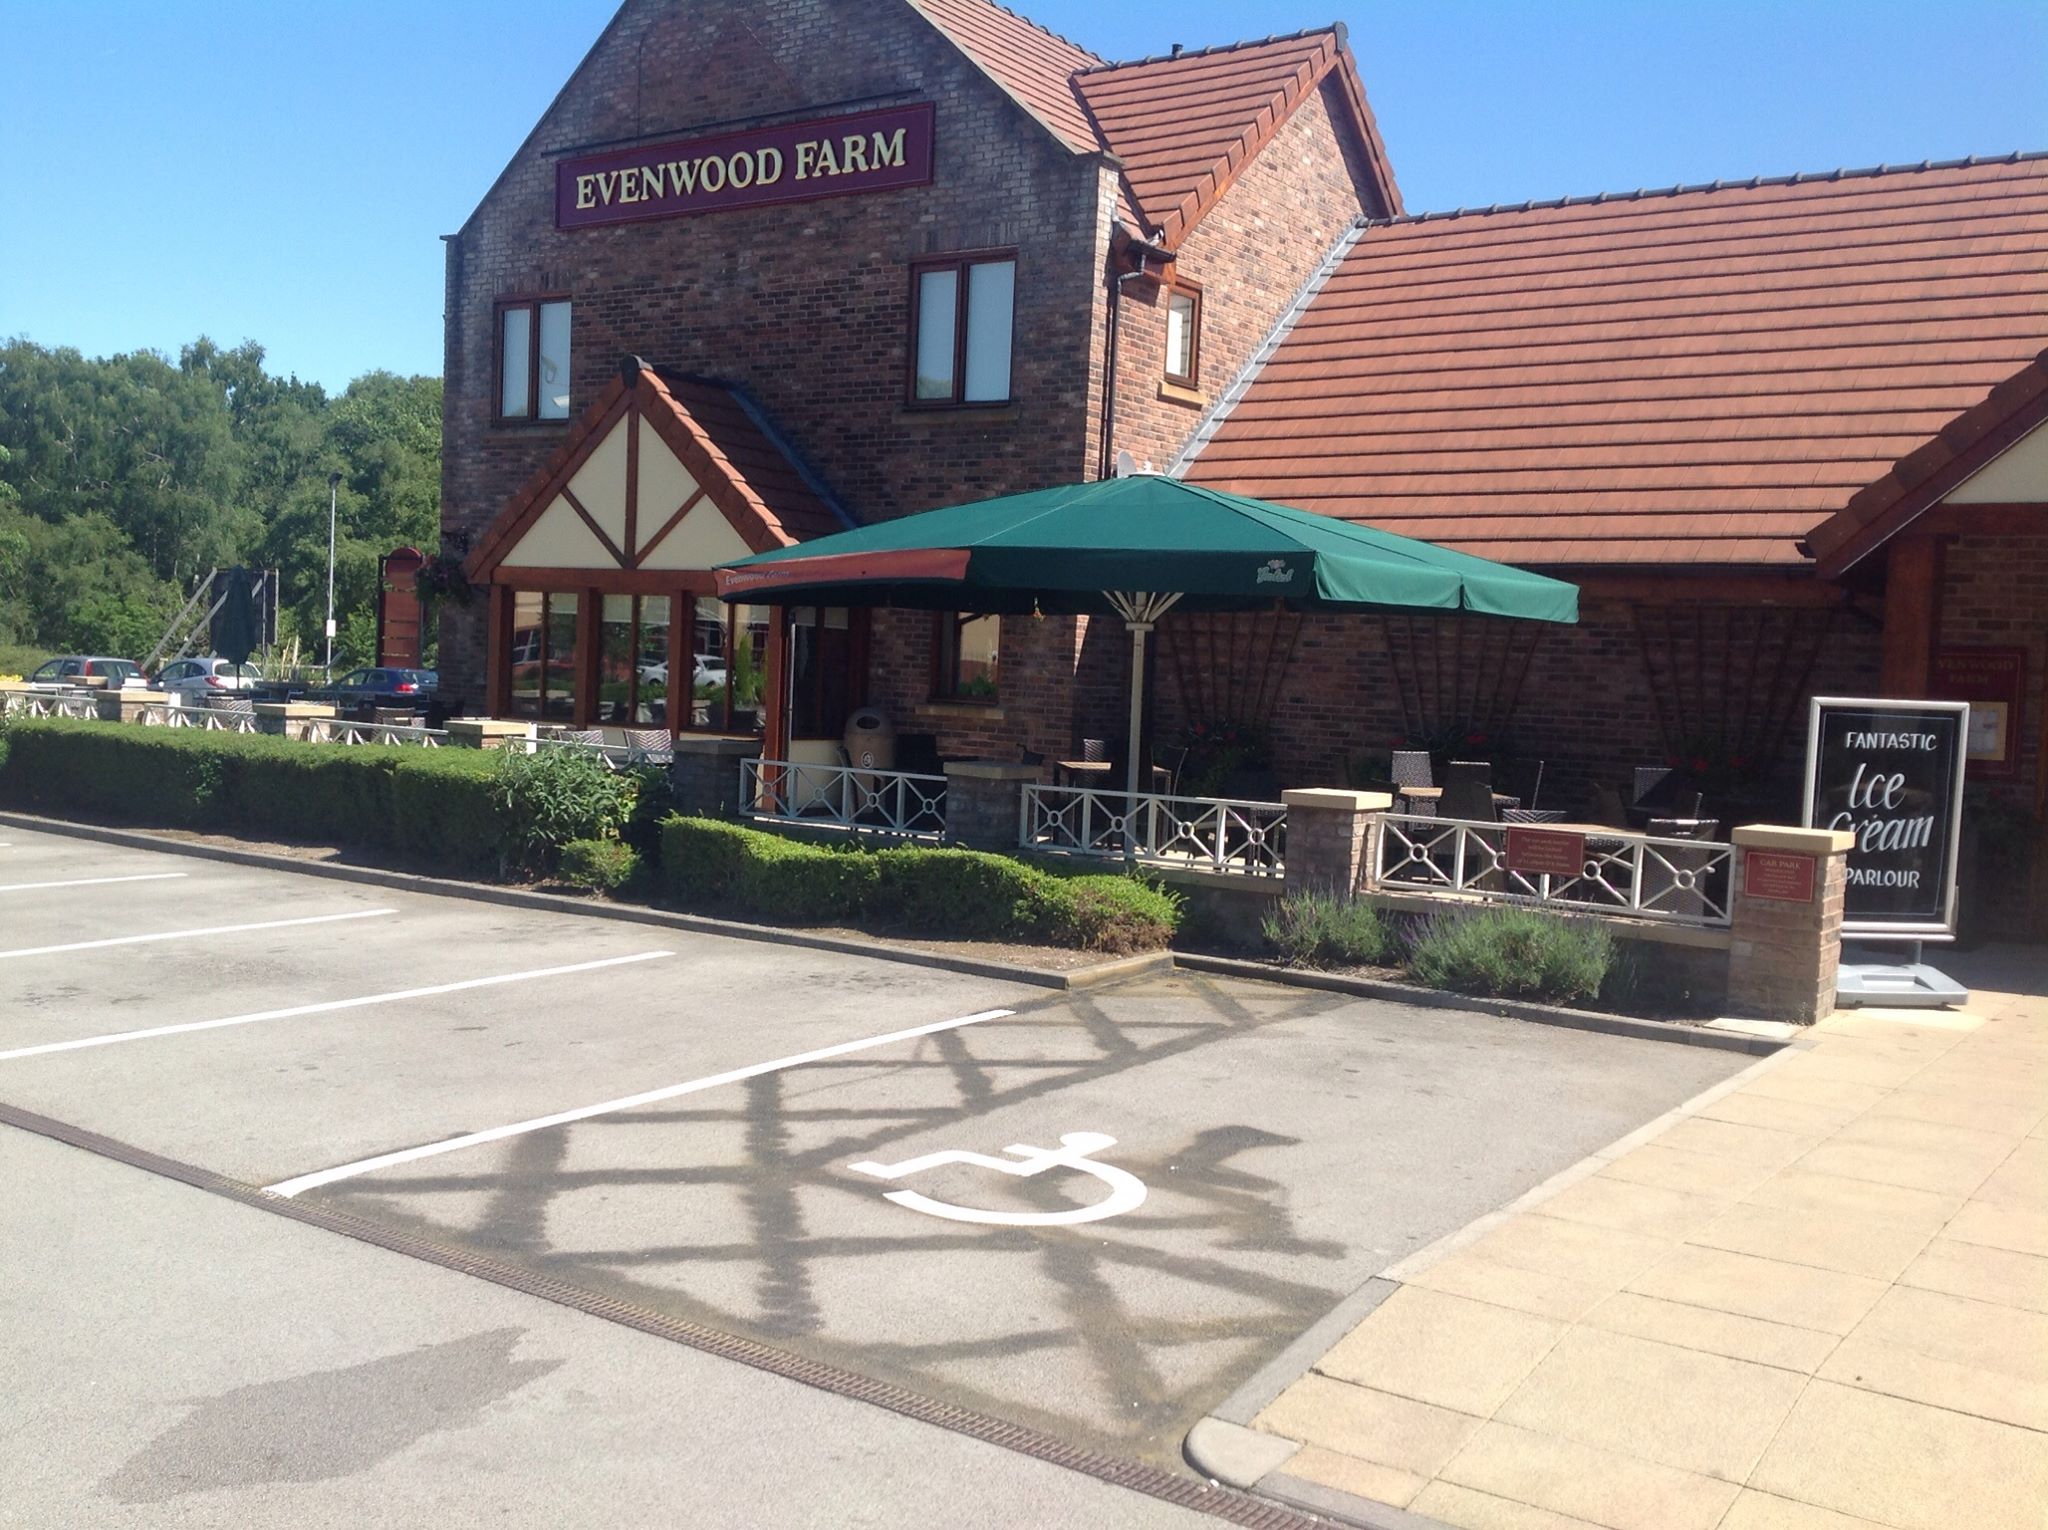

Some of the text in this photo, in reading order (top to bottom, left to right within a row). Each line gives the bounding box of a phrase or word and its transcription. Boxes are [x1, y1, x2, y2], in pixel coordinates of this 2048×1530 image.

[576, 128, 907, 210] EVENWOOD FARM
[1846, 732, 1938, 751] FANTASTIC
[1849, 762, 1907, 810] Ice
[1779, 860, 1801, 870] PARK
[1846, 867, 1921, 889] PARLOUR
